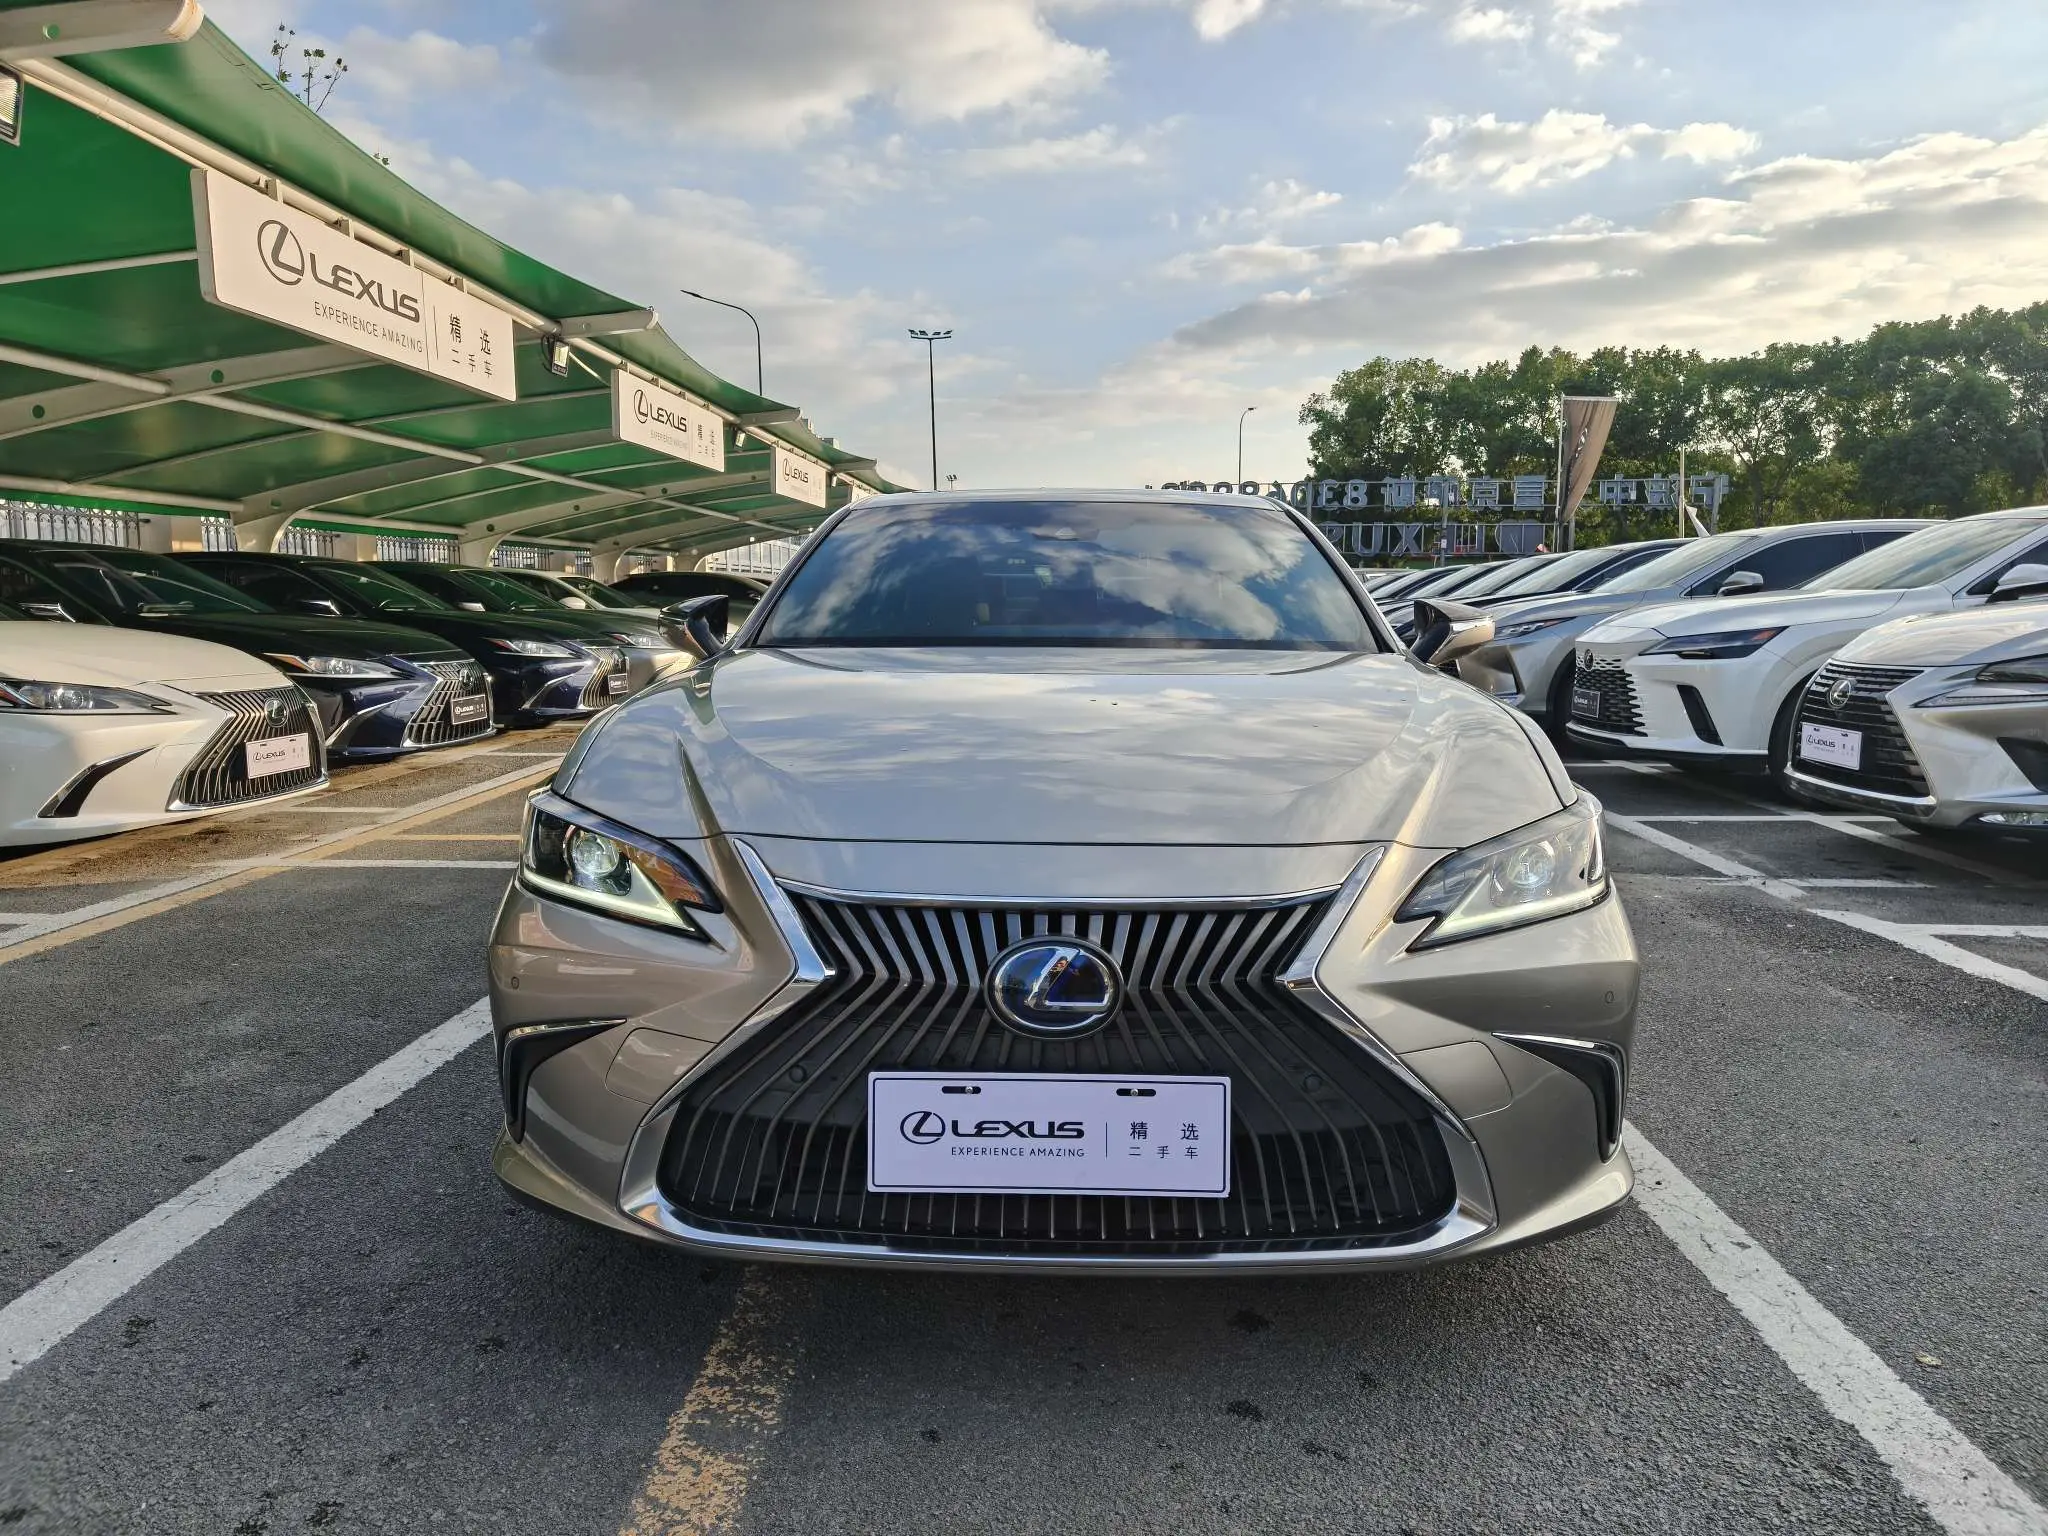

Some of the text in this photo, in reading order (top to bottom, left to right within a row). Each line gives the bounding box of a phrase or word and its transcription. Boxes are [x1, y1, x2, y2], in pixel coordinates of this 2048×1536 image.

[310, 252, 420, 323] LEXUS
[314, 301, 424, 353] EXPERIENCE AMAZING
[650, 403, 687, 432] LEXUS
[951, 1119, 1085, 1139] LEXUS
[1129, 1120, 1200, 1141] 精选
[951, 1146, 1086, 1158] EXPERIENCE AMAZING
[1129, 1145, 1199, 1160] 二手车
